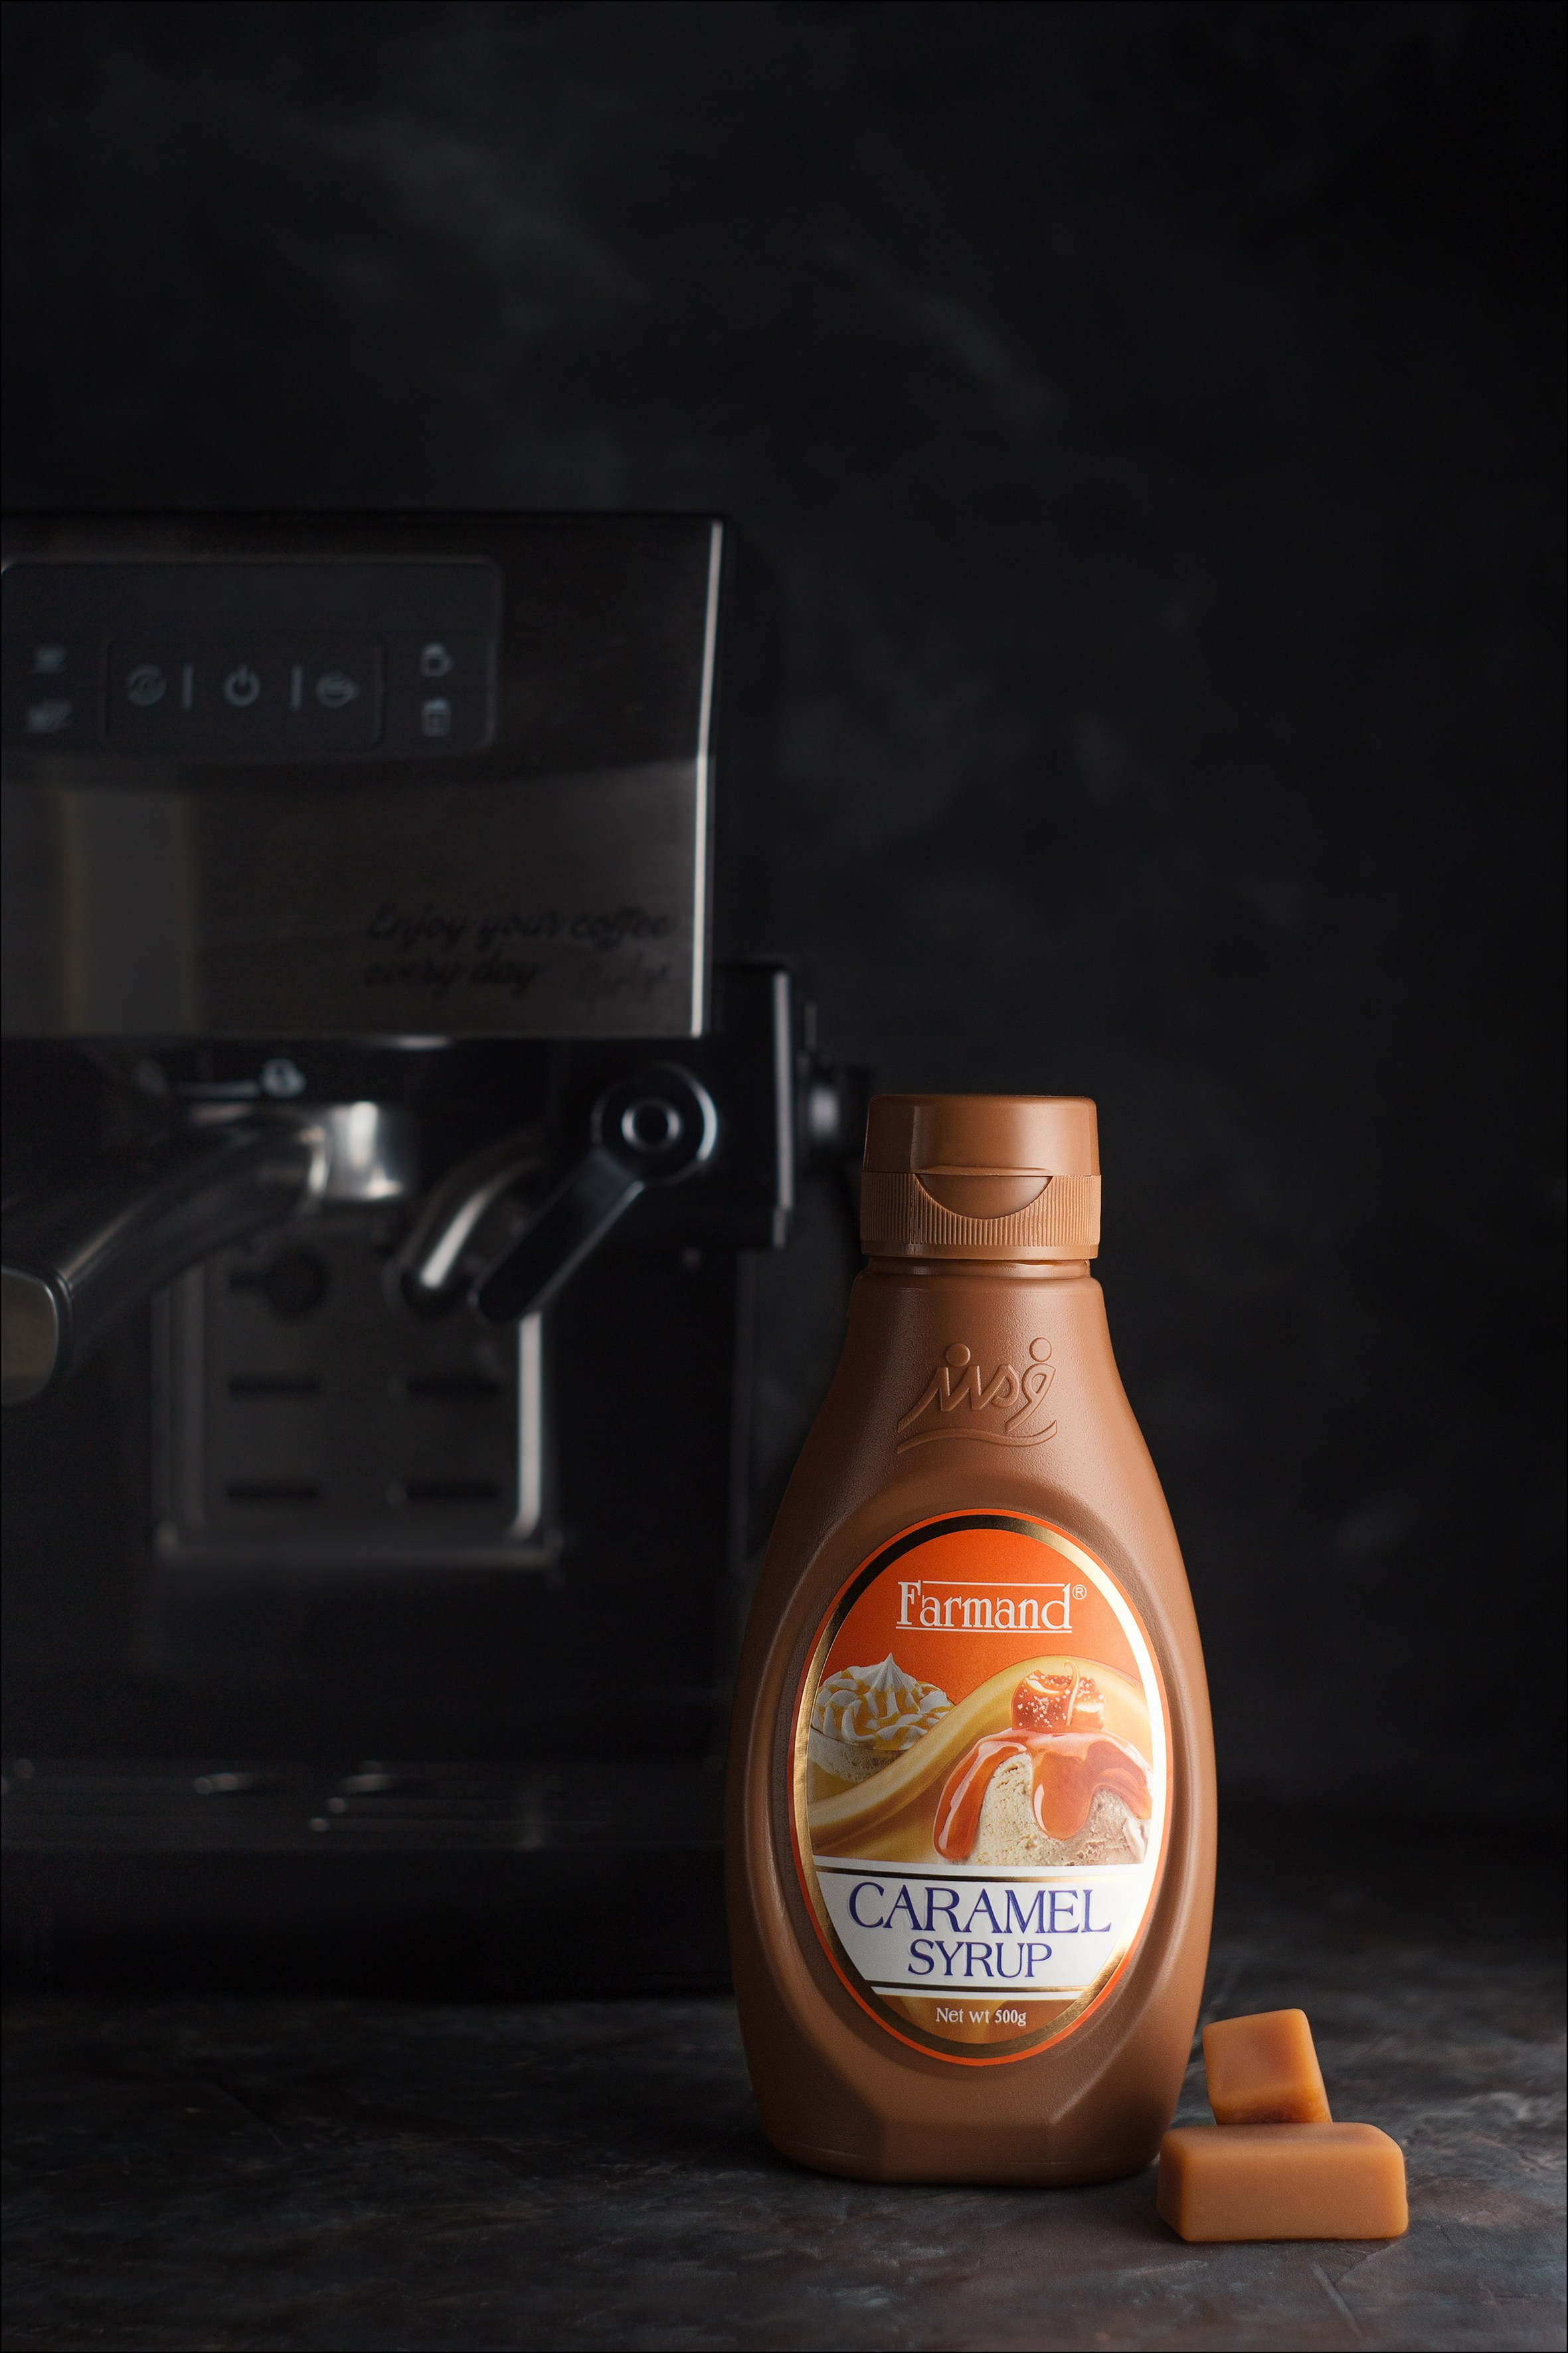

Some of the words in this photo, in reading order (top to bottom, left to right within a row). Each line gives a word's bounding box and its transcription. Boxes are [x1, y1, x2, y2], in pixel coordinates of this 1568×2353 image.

[848, 1881, 1112, 1935] CARAMEL
[907, 1938, 1053, 1978] SYRUP
[935, 2007, 964, 2023] Net
[968, 2009, 990, 2024] wt
[994, 2008, 1027, 2027] 500g
